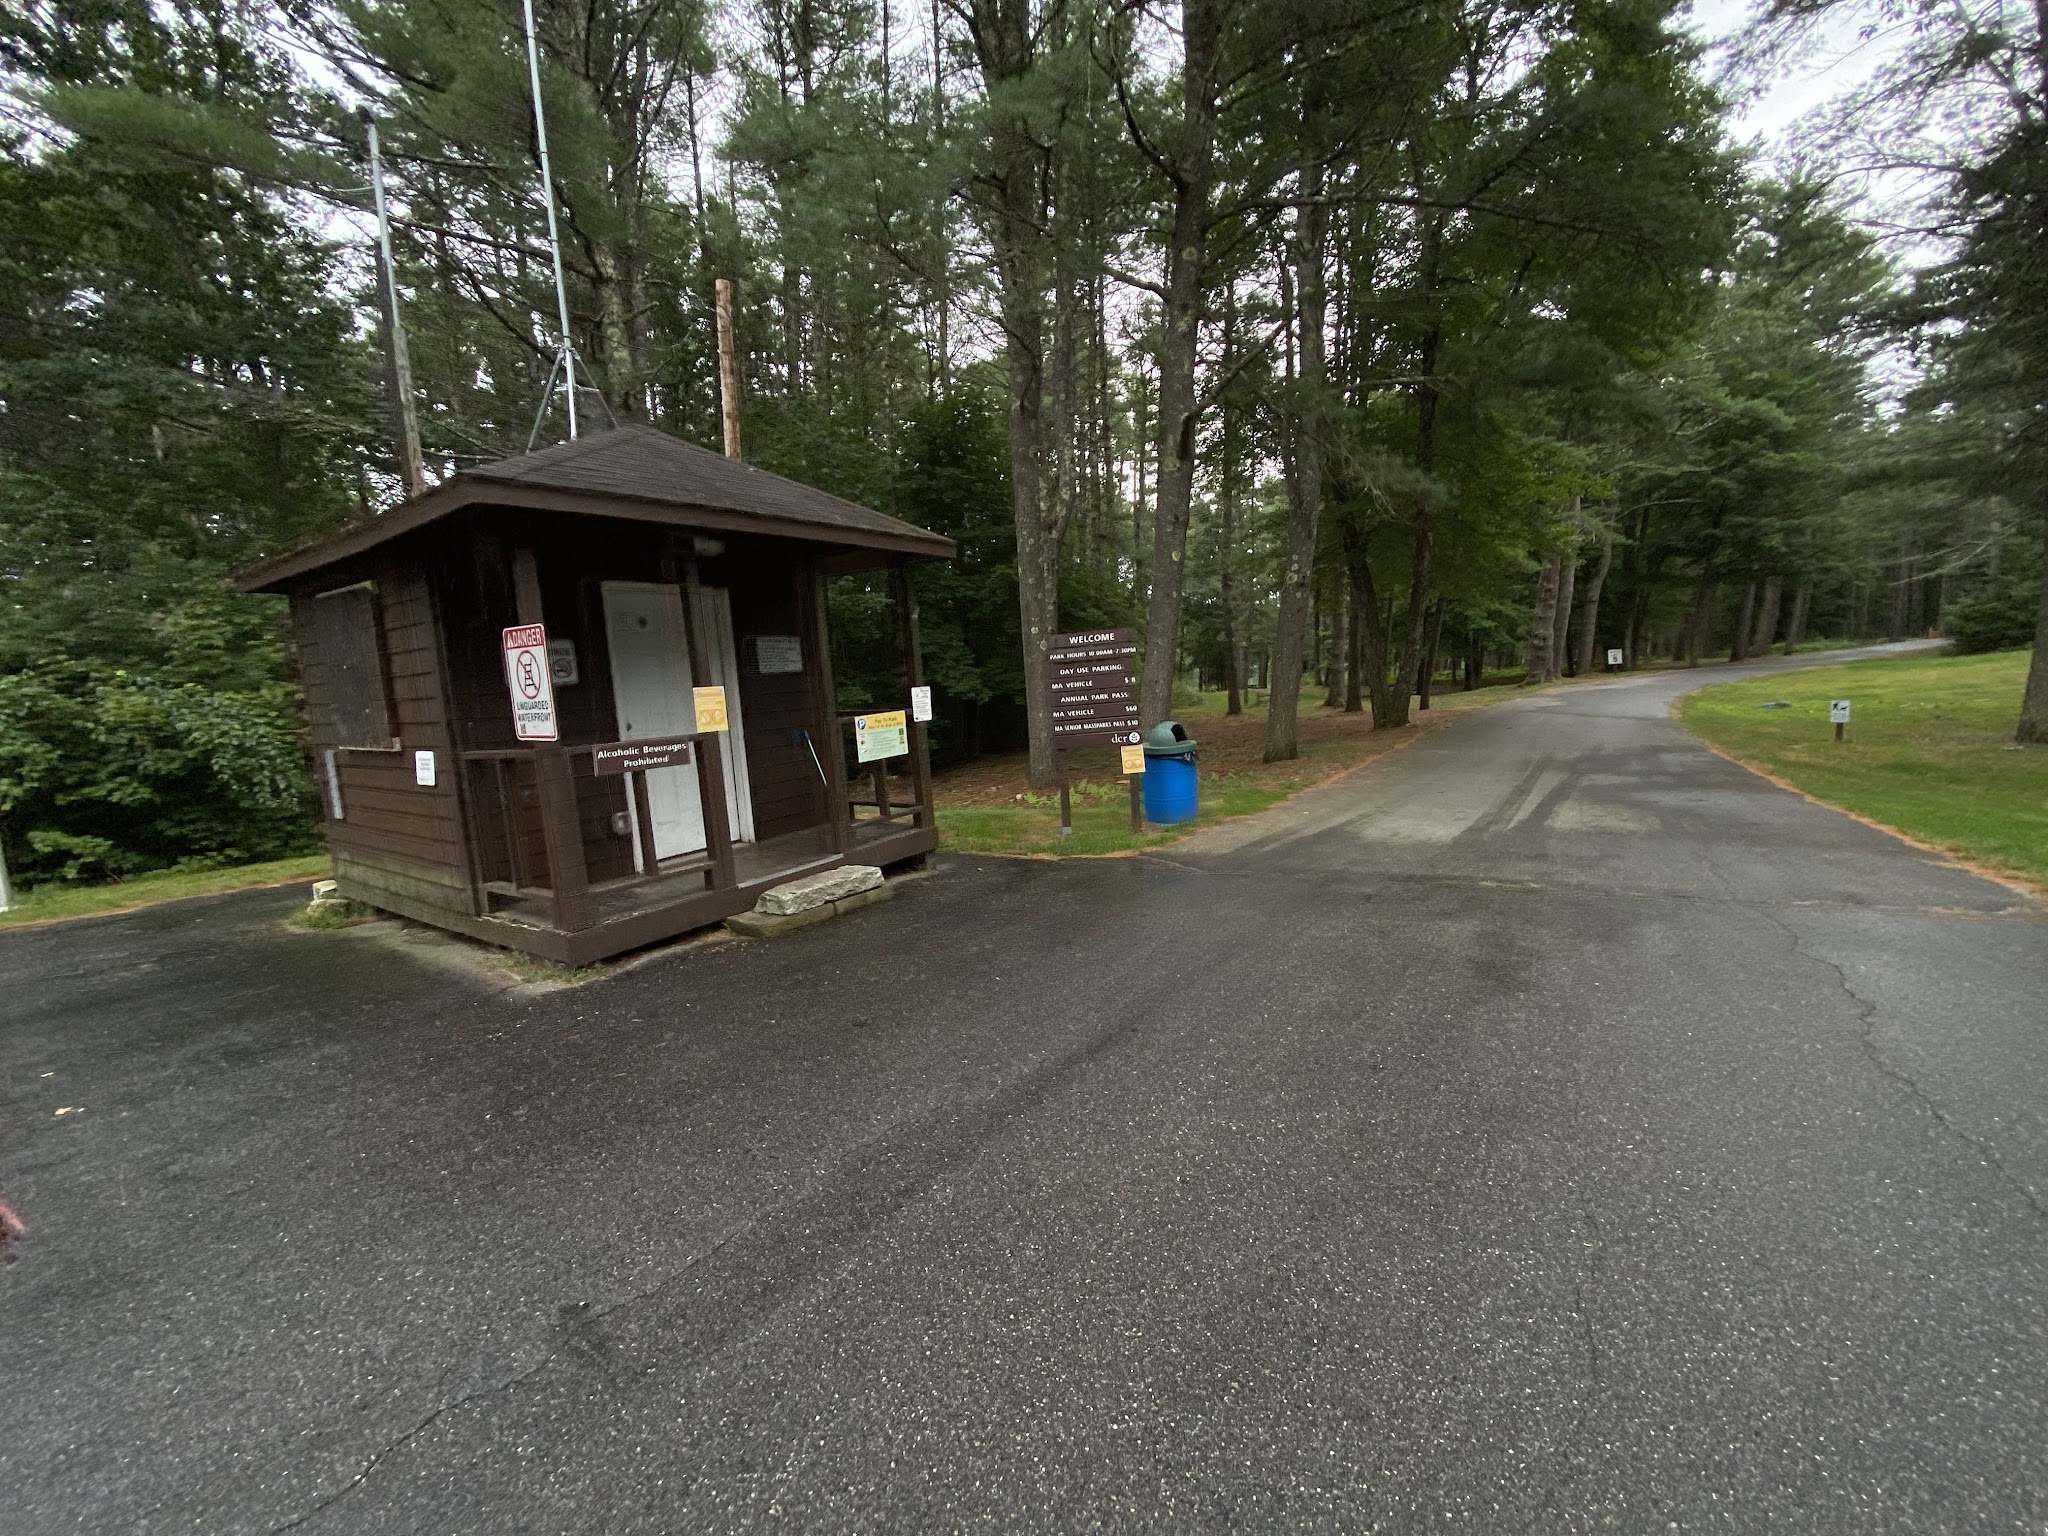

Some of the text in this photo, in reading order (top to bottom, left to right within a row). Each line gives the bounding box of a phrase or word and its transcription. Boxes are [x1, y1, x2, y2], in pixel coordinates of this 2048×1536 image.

[512, 628, 542, 647] DANGER
[1069, 633, 1115, 644] WELCOME
[1066, 651, 1087, 659] HOURS
[1076, 666, 1089, 674] USE
[1092, 663, 1122, 672] PARKING
[1065, 680, 1093, 688] VEHICLE
[1060, 691, 1128, 703] ANNUAL PARK PASS
[516, 700, 549, 711] UNGUARDED
[517, 712, 552, 722] WATERFRONT
[1066, 708, 1094, 717] VEHICLE
[1064, 723, 1082, 731] SENIOR
[1083, 721, 1112, 730] MASSPARKS
[1112, 720, 1125, 728] PASS
[1127, 719, 1139, 727] $10
[1111, 733, 1128, 744] dcr
[597, 741, 687, 760] Alcoholic Beverages
[623, 754, 670, 768] Prohibited
